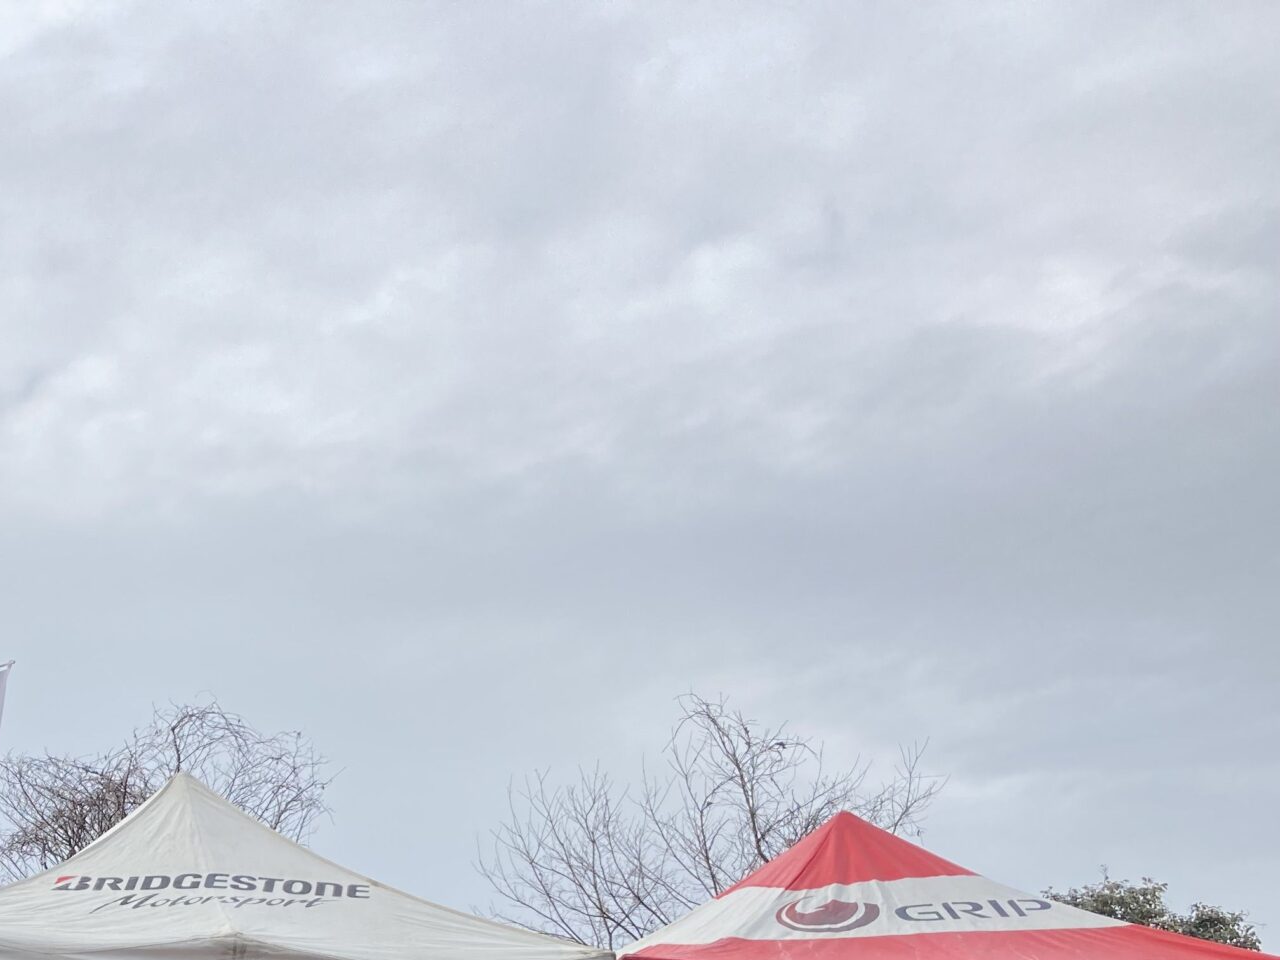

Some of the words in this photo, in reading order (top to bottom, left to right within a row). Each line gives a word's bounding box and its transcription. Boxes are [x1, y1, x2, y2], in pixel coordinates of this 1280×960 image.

[50, 873, 371, 900] BRIDGESTONE
[89, 893, 327, 915] Motorsport
[894, 899, 1052, 922] GRIP
